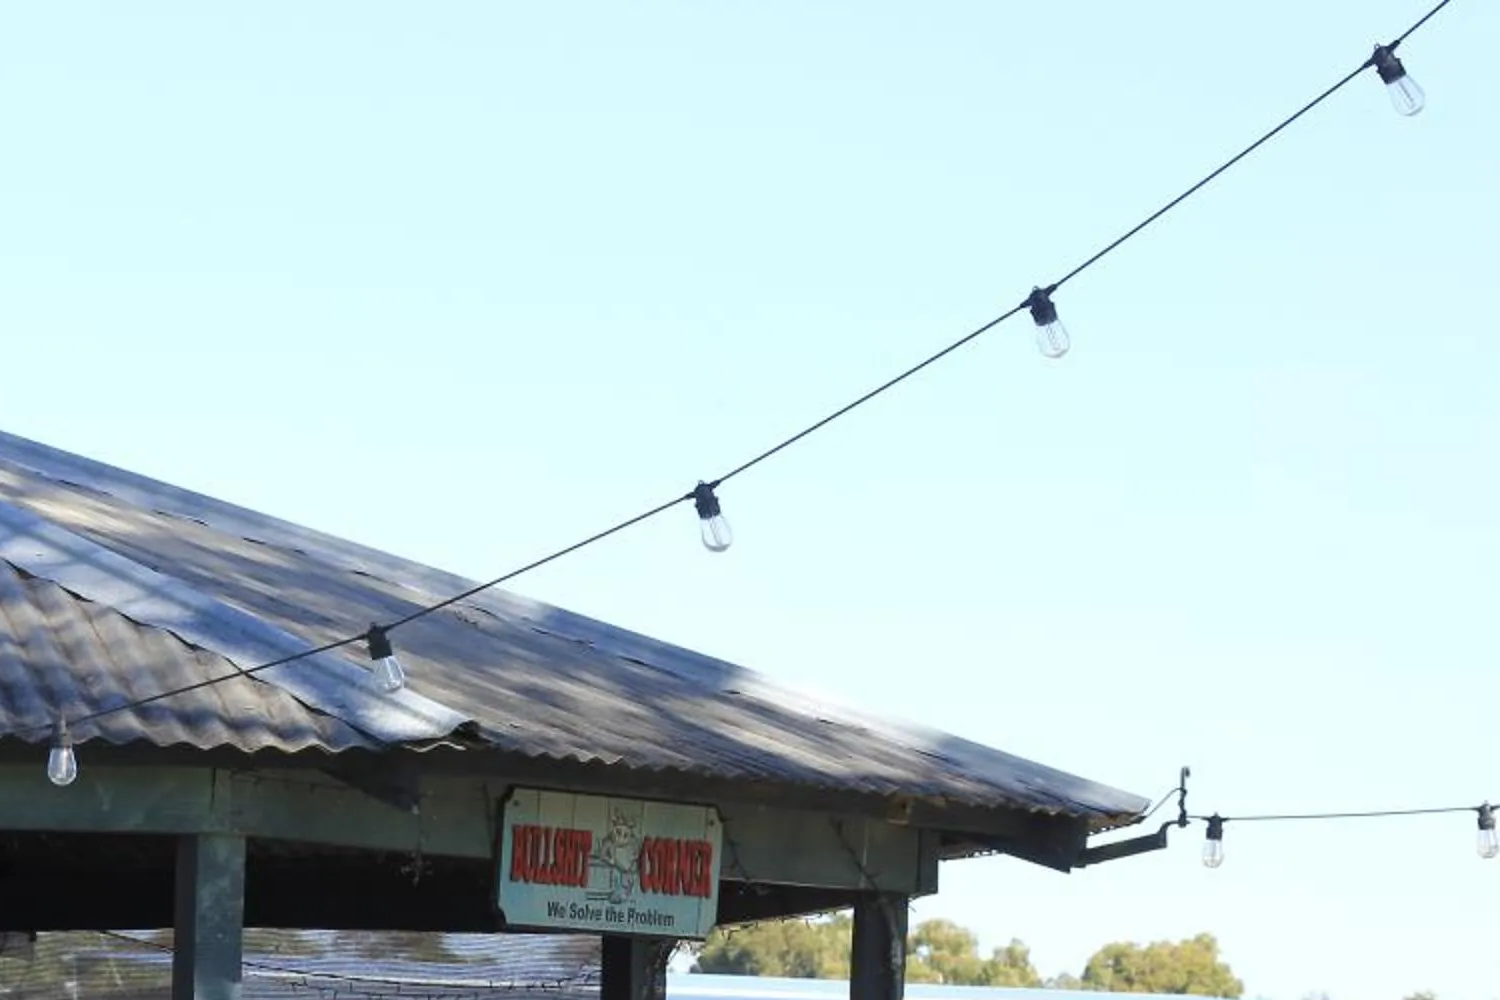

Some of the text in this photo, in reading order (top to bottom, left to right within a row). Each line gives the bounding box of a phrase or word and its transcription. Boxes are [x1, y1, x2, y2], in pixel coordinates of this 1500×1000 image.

[510, 824, 712, 898] BULLSHIT CORNER
[547, 901, 675, 927] We Solve the Problem
